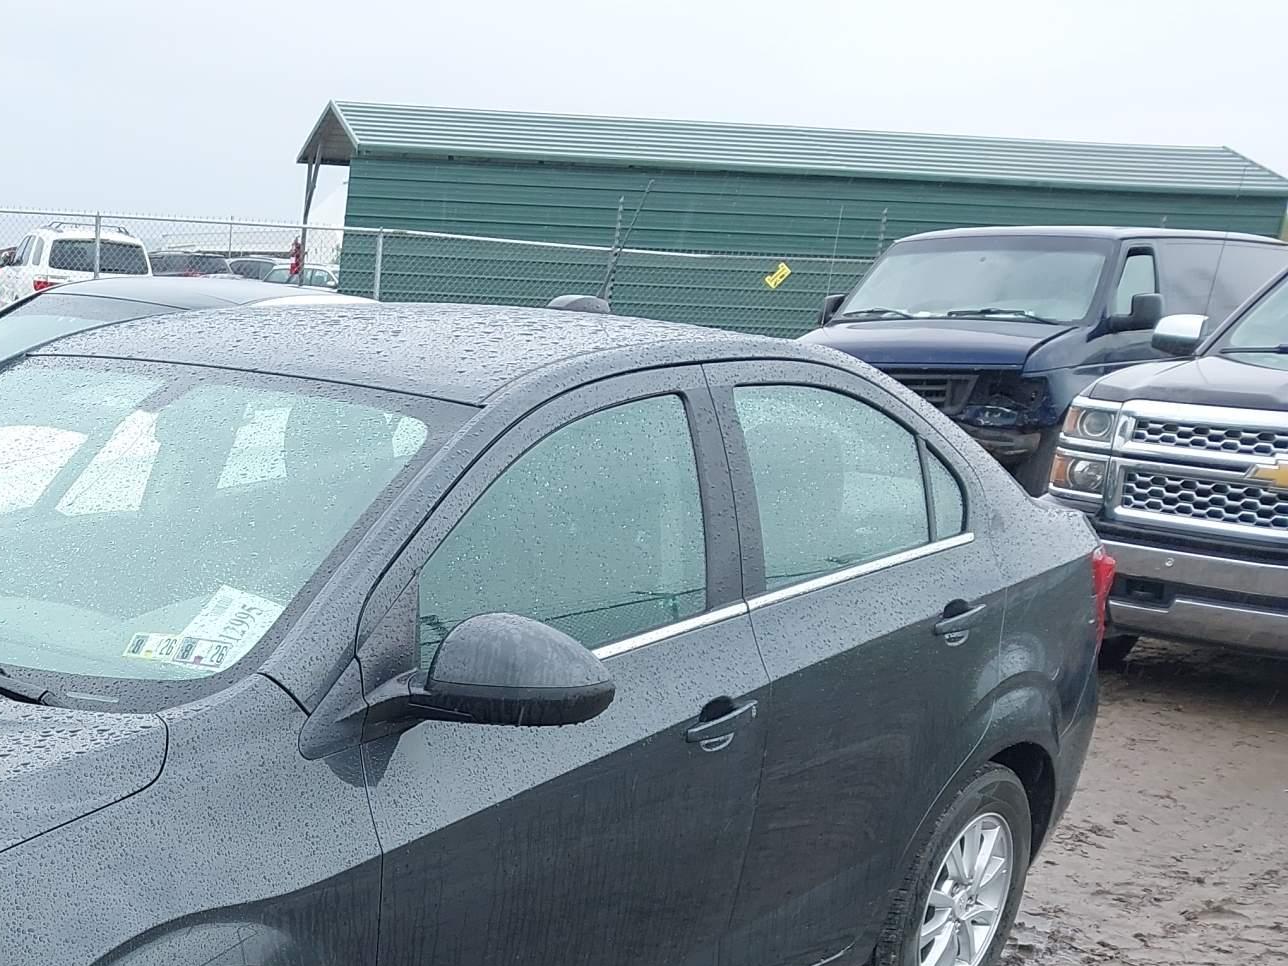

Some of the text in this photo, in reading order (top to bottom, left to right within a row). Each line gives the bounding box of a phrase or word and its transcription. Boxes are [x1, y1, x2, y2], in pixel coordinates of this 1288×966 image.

[218, 603, 264, 642] 12995
[159, 638, 178, 656] 26
[210, 644, 229, 664] 26
